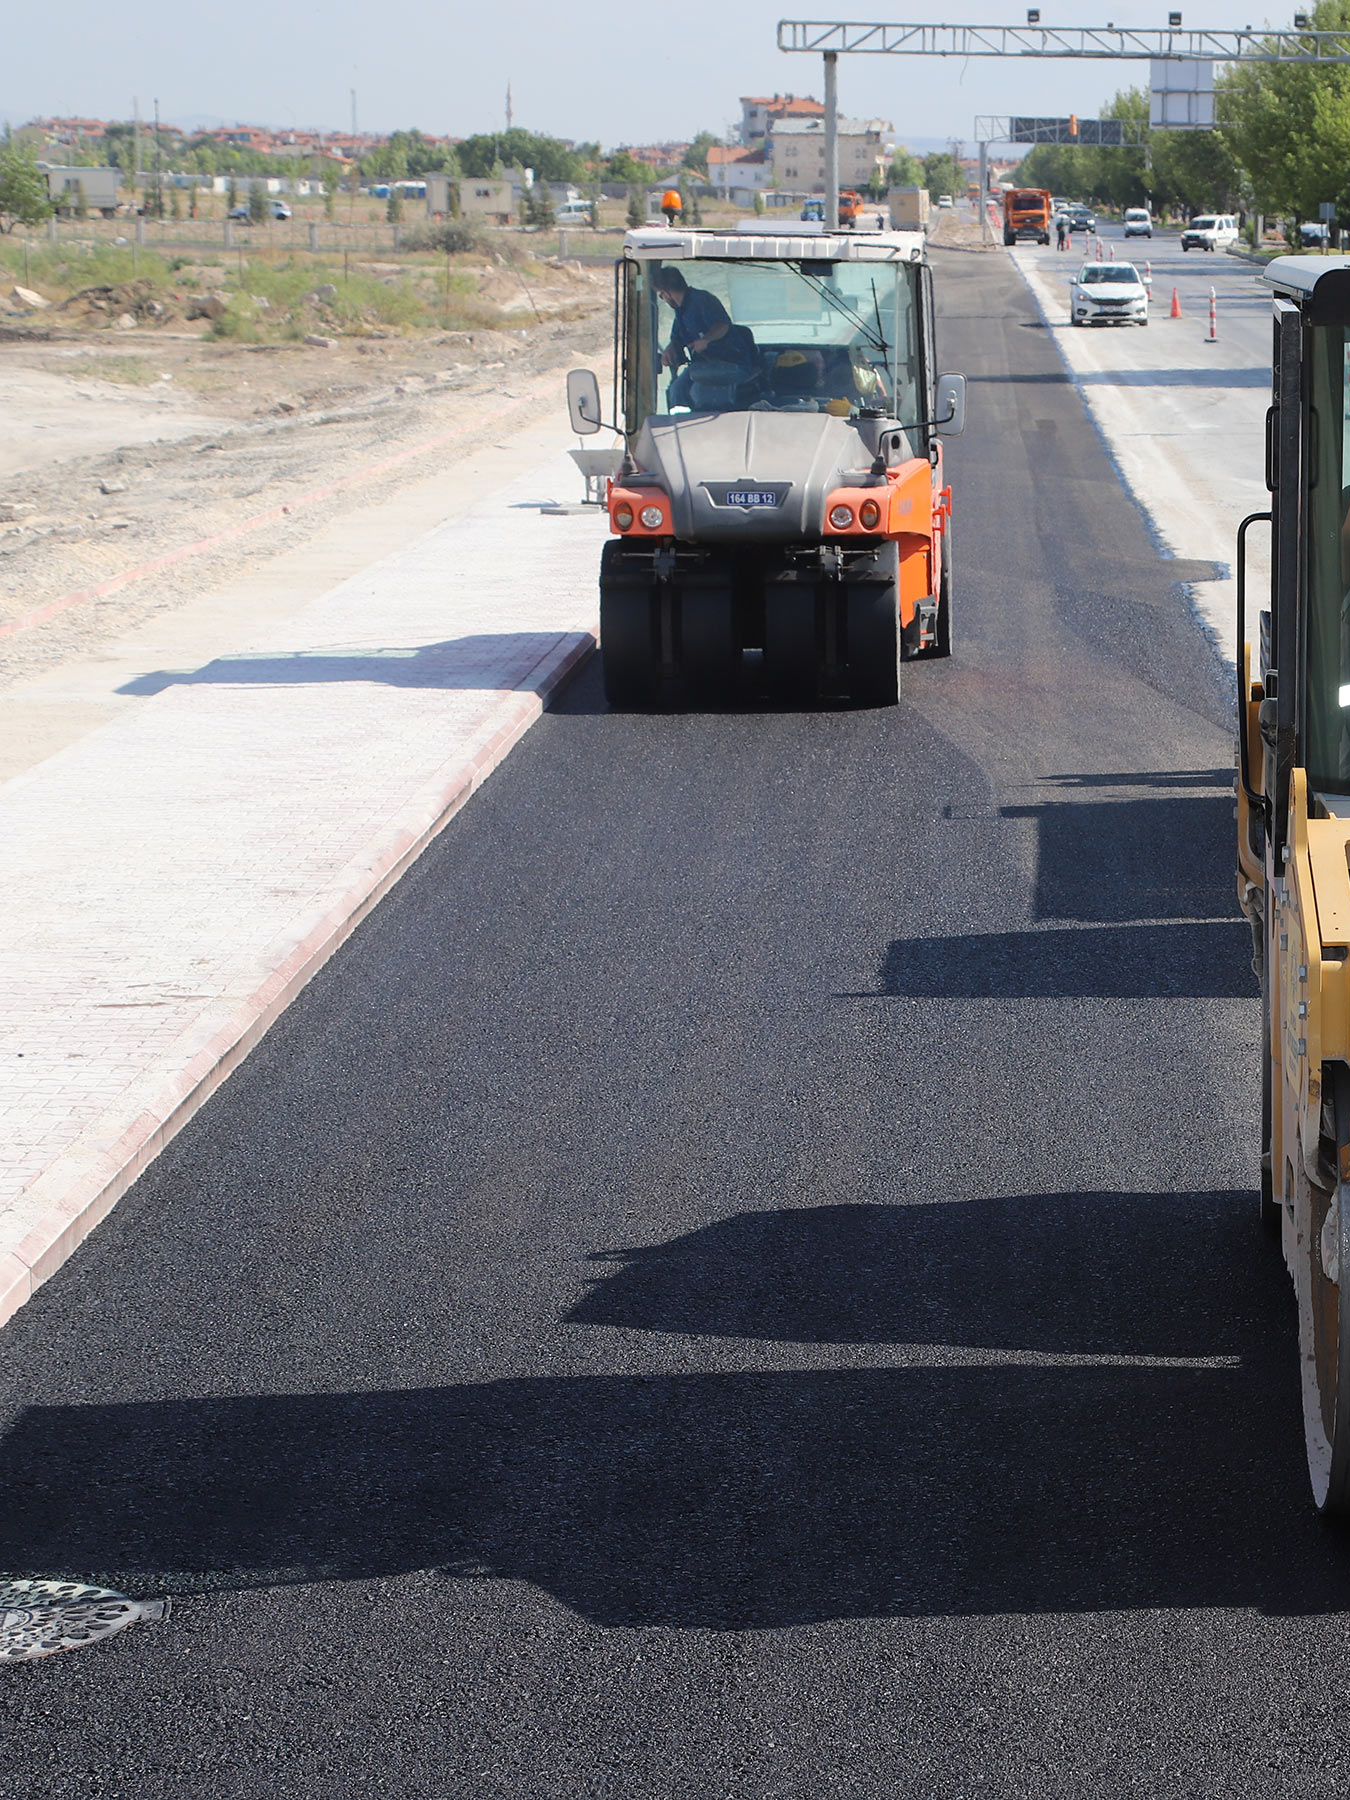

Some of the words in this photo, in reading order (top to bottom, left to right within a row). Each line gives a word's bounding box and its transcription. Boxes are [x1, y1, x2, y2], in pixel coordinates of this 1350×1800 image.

[730, 494, 745, 503] 164
[748, 494, 760, 503] BB
[762, 494, 773, 503] 12
